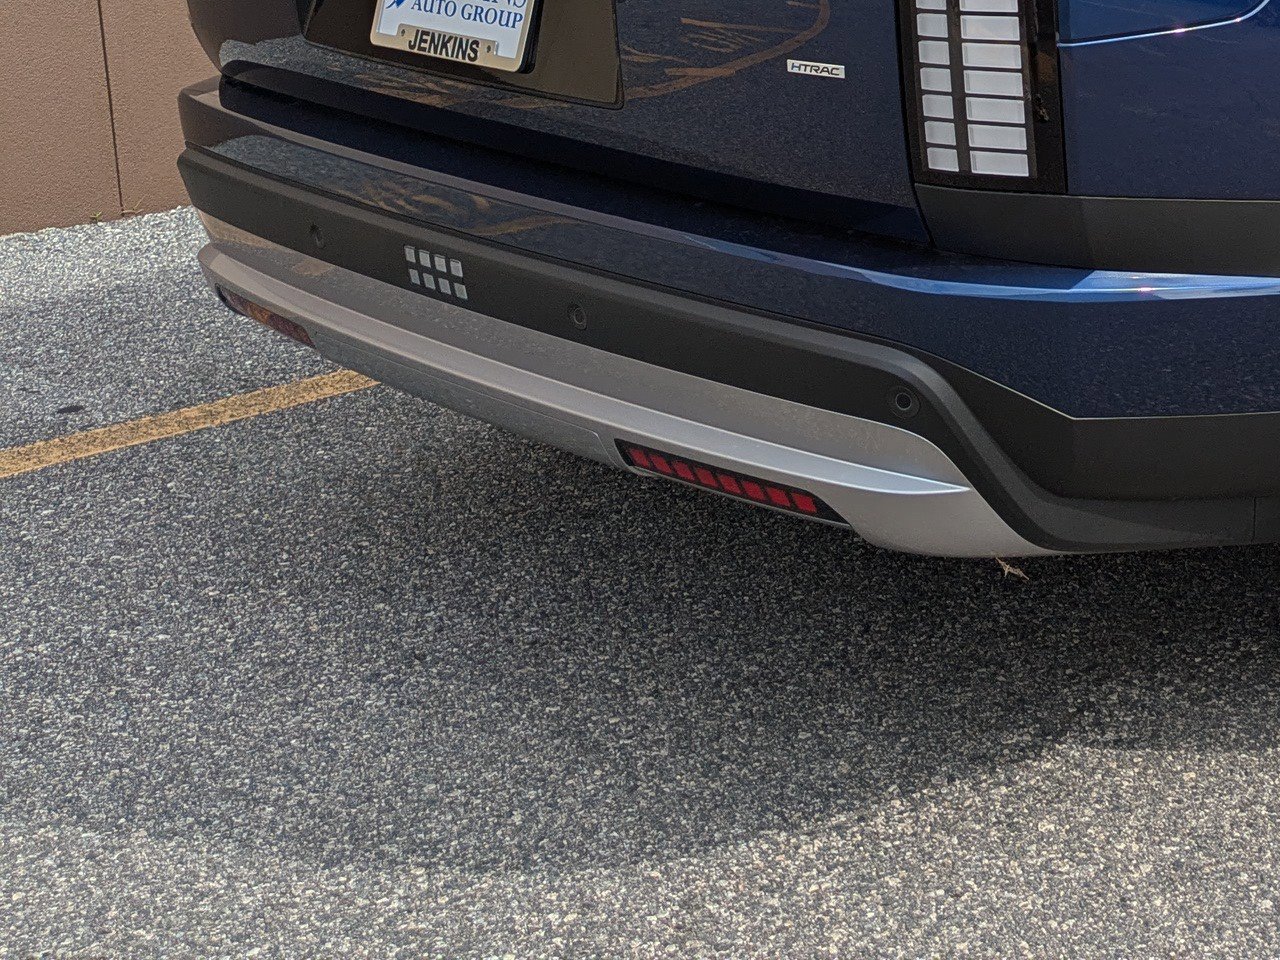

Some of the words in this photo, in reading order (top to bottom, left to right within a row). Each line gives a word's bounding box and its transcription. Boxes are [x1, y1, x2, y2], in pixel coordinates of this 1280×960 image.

[460, 3, 524, 29] GROUP
[408, 28, 480, 62] JENKINS
[790, 62, 840, 76] HTRAC
